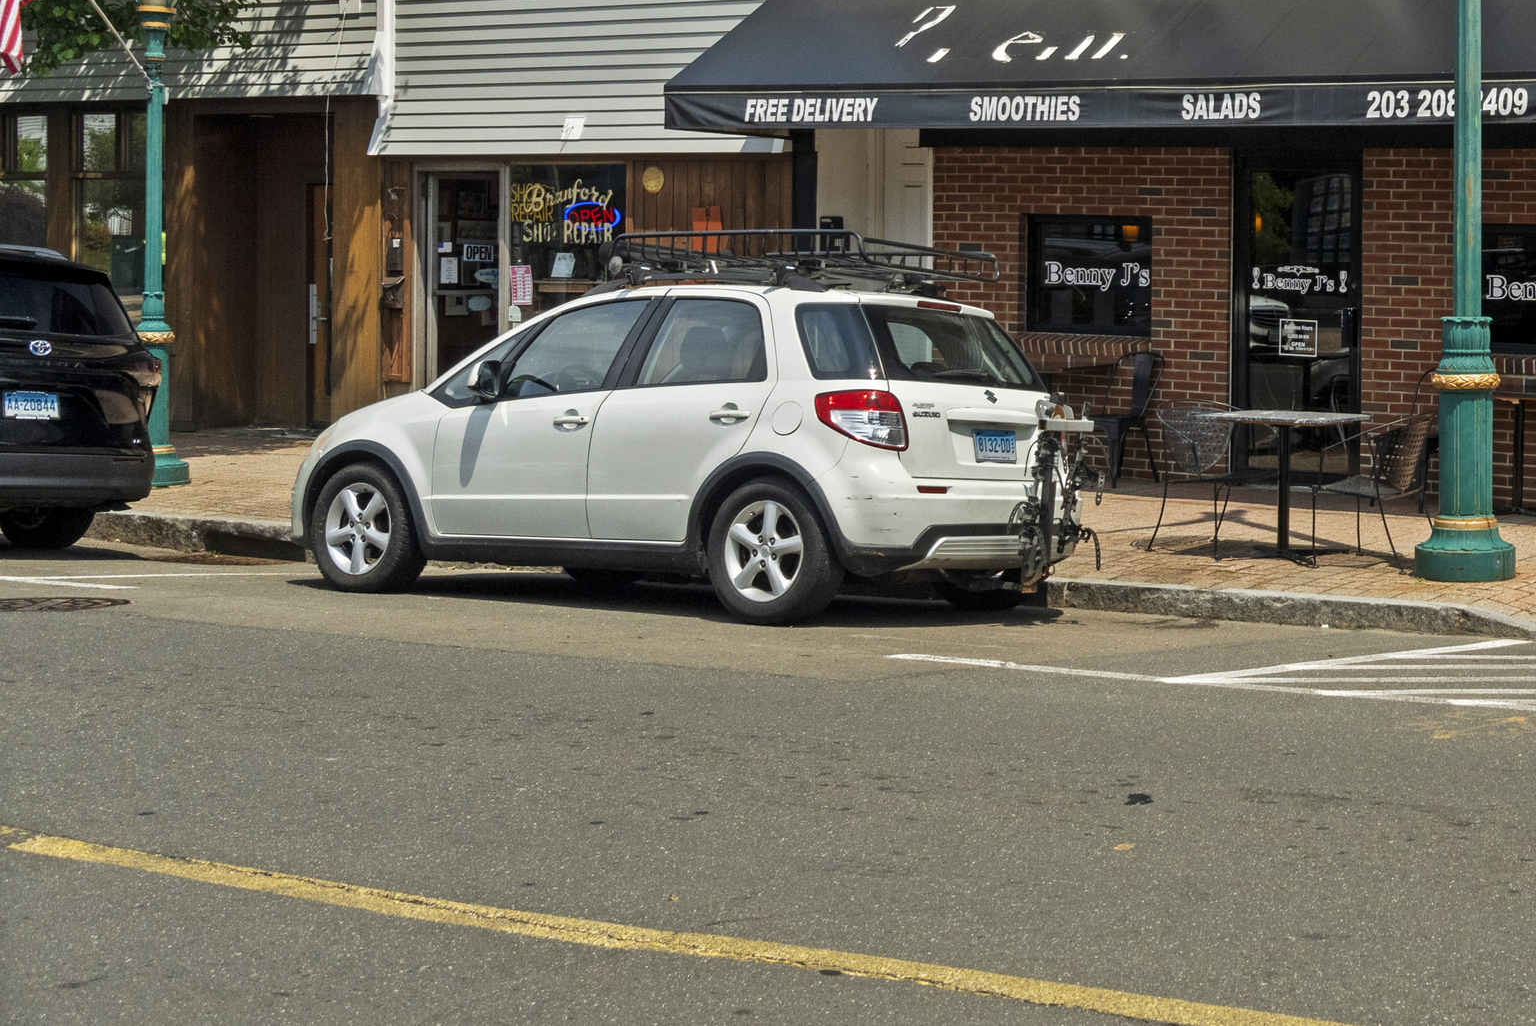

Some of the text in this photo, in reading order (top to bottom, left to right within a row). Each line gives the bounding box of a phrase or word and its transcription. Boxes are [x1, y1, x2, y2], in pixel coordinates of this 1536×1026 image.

[744, 97, 879, 123] FREE DELIVERY
[969, 95, 1081, 122] SMOOTHIES
[1181, 92, 1262, 121] SALADS
[1366, 90, 1410, 119] 203
[1479, 87, 1529, 116] 409
[567, 207, 615, 226] OPEN
[466, 245, 493, 261] OPEN
[1044, 260, 1151, 292] Benny J's
[1262, 273, 1335, 295] Benny J's
